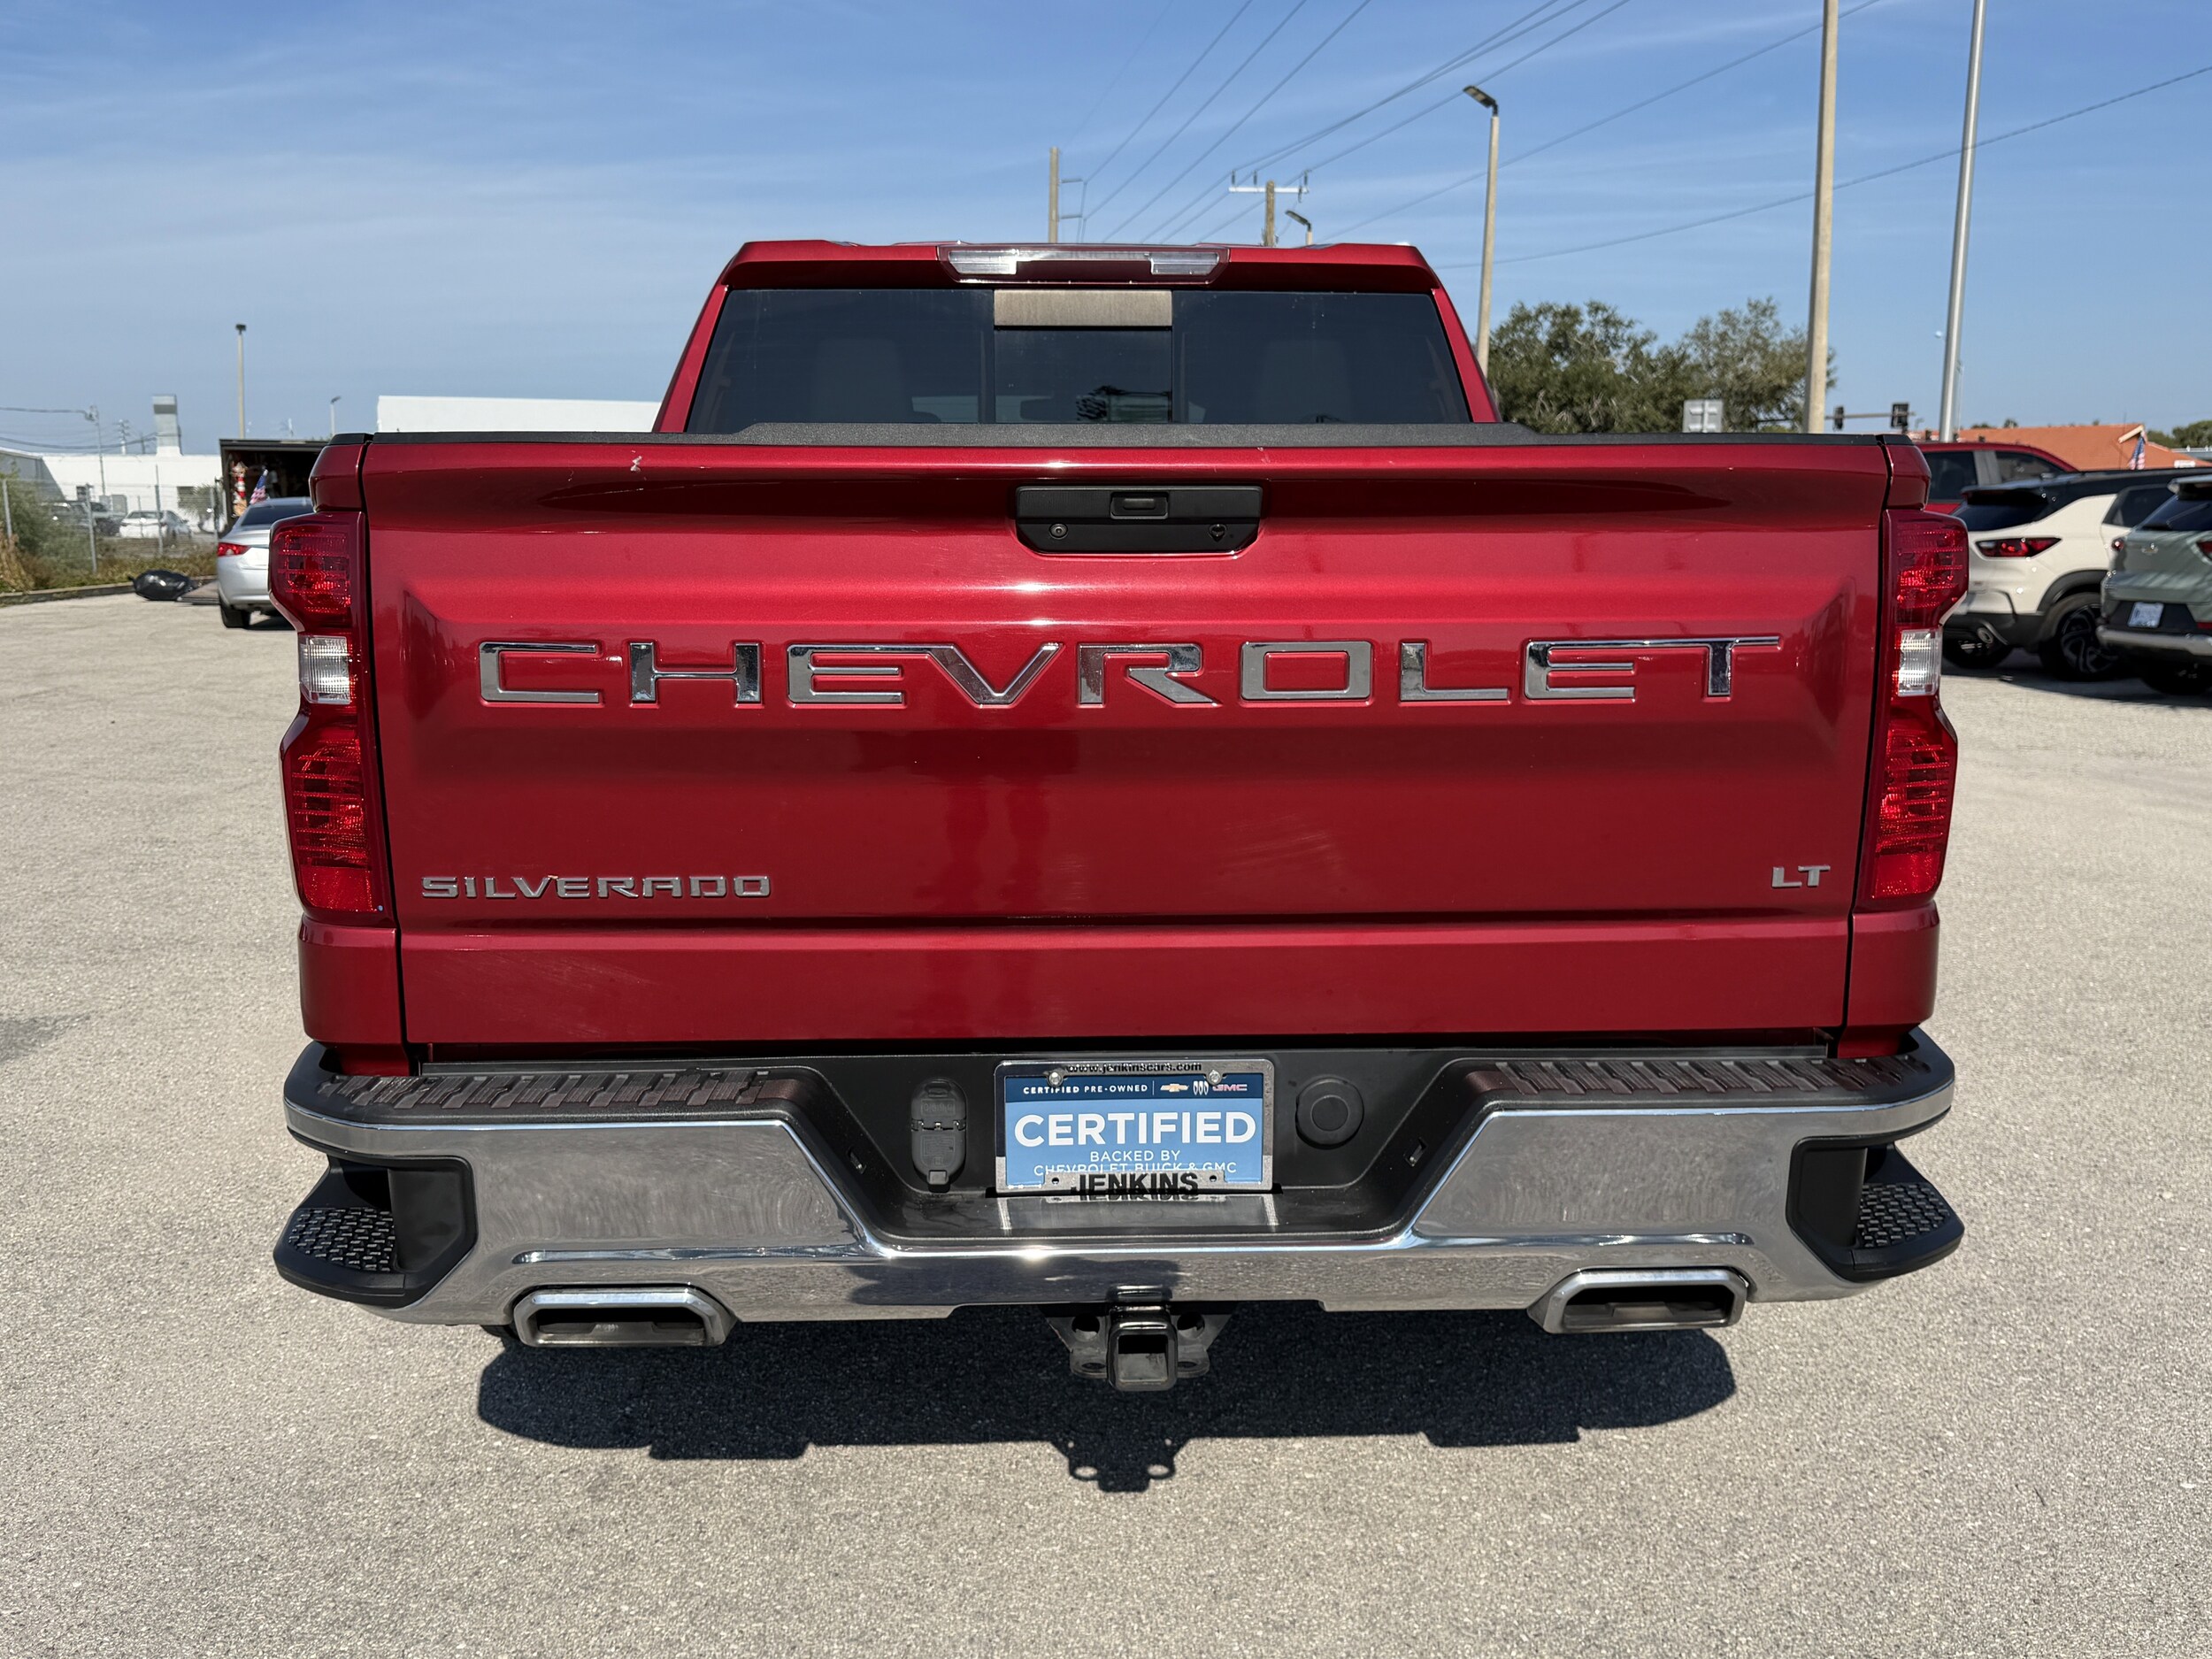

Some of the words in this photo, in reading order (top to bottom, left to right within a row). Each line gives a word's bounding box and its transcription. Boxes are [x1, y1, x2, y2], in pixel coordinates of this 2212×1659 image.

[479, 634, 1780, 710] CHEVROLET
[421, 875, 772, 898] SILVERADO
[1771, 865, 1831, 887] LT
[1066, 1062, 1202, 1073] www.jenkinscars.com
[1023, 1086, 1080, 1094] CERTIFIED
[1014, 1111, 1256, 1147] CERTIFIED
[1090, 1151, 1154, 1162] BACKED
[1161, 1150, 1180, 1161] BY
[1203, 1162, 1237, 1173] GMC
[1070, 1172, 1199, 1195] JENKINS
